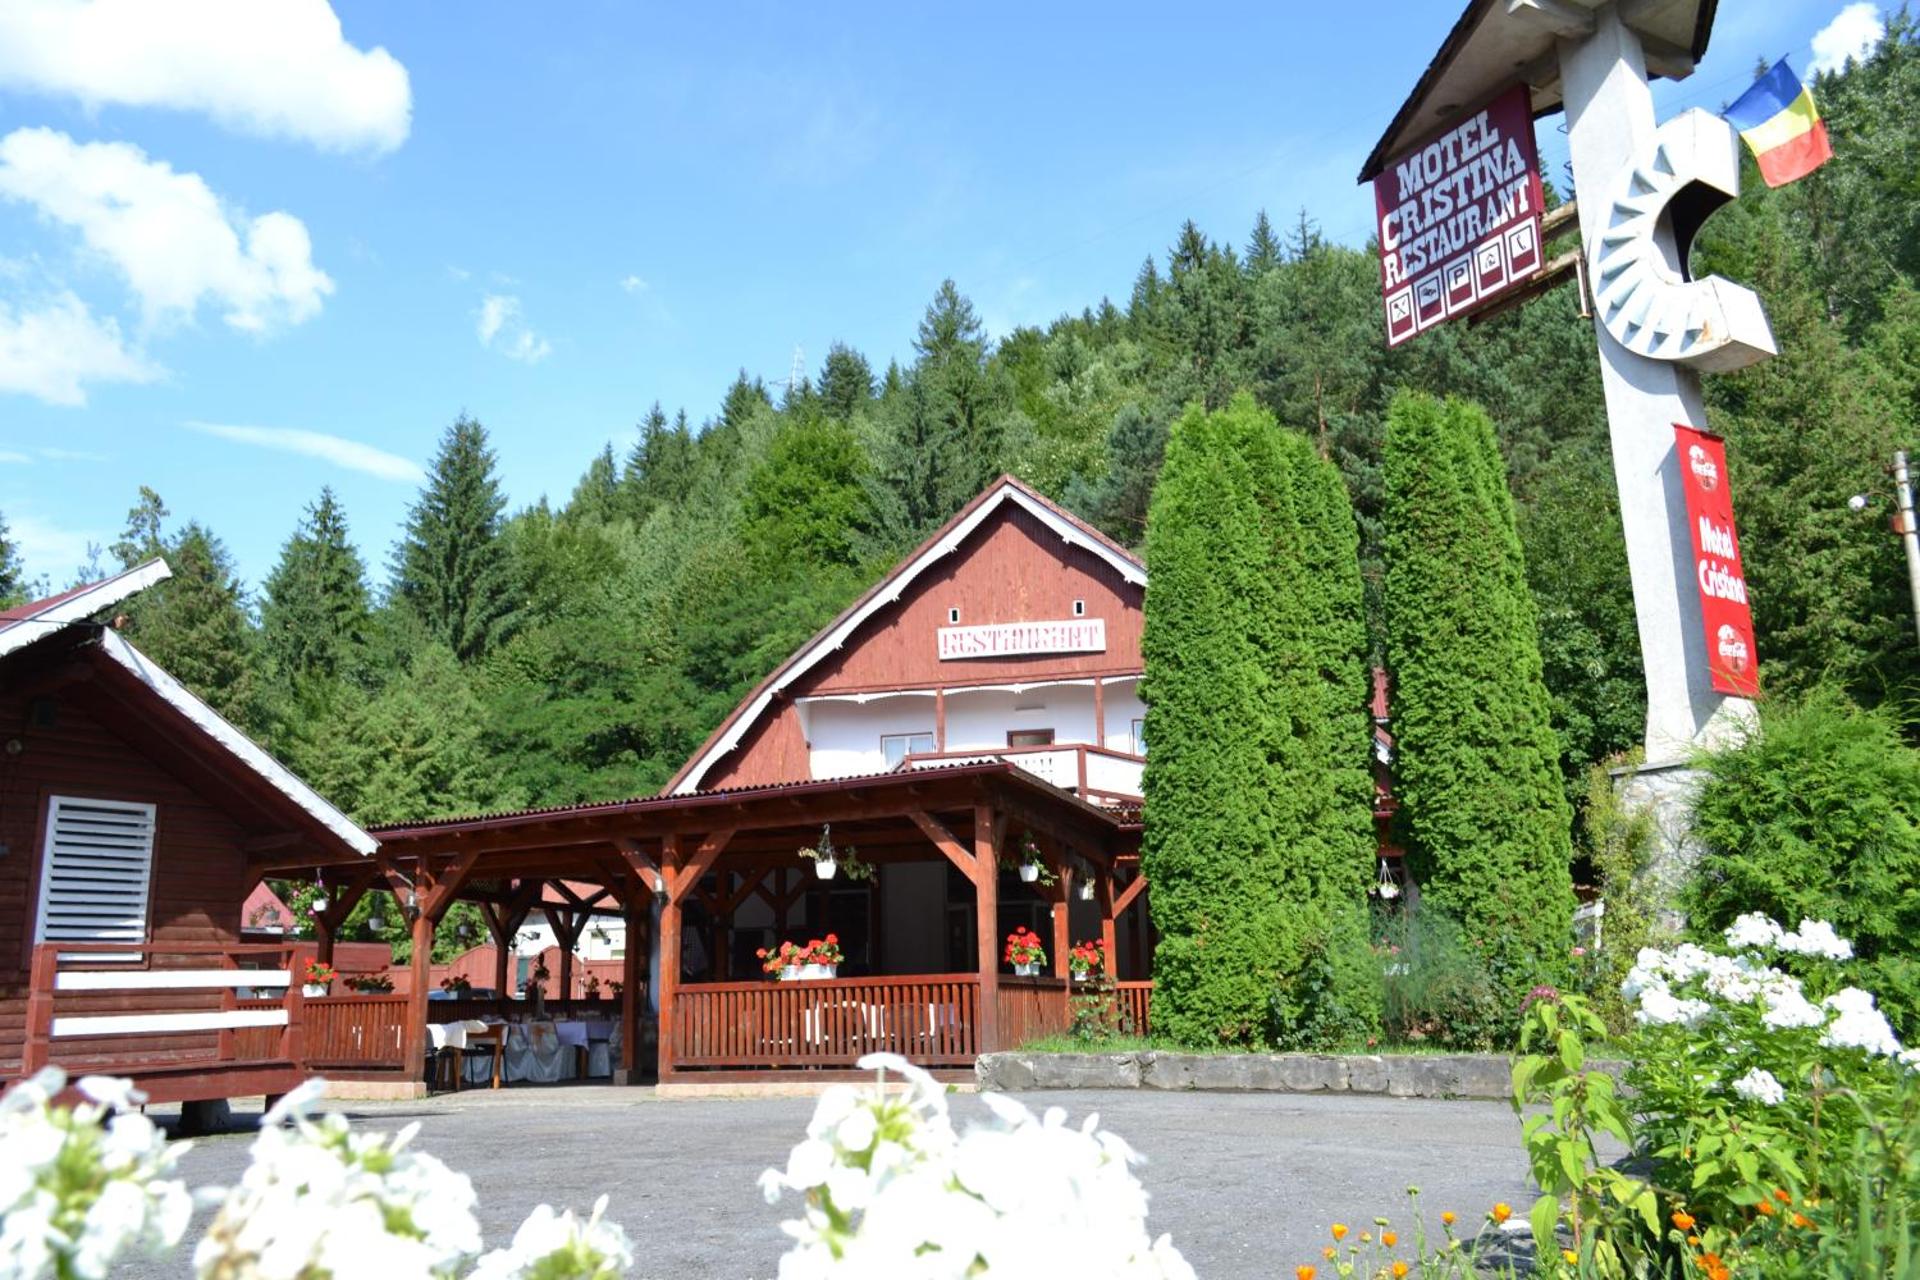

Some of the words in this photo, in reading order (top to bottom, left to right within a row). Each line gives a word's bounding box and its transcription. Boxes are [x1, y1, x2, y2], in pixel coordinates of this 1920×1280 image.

[1382, 136, 1527, 252] CRISTINA
[1396, 110, 1499, 201] MOTEL
[1382, 173, 1530, 290] RESTAURANT
[1698, 558, 1748, 605] Cristina
[1699, 515, 1736, 561] Motel
